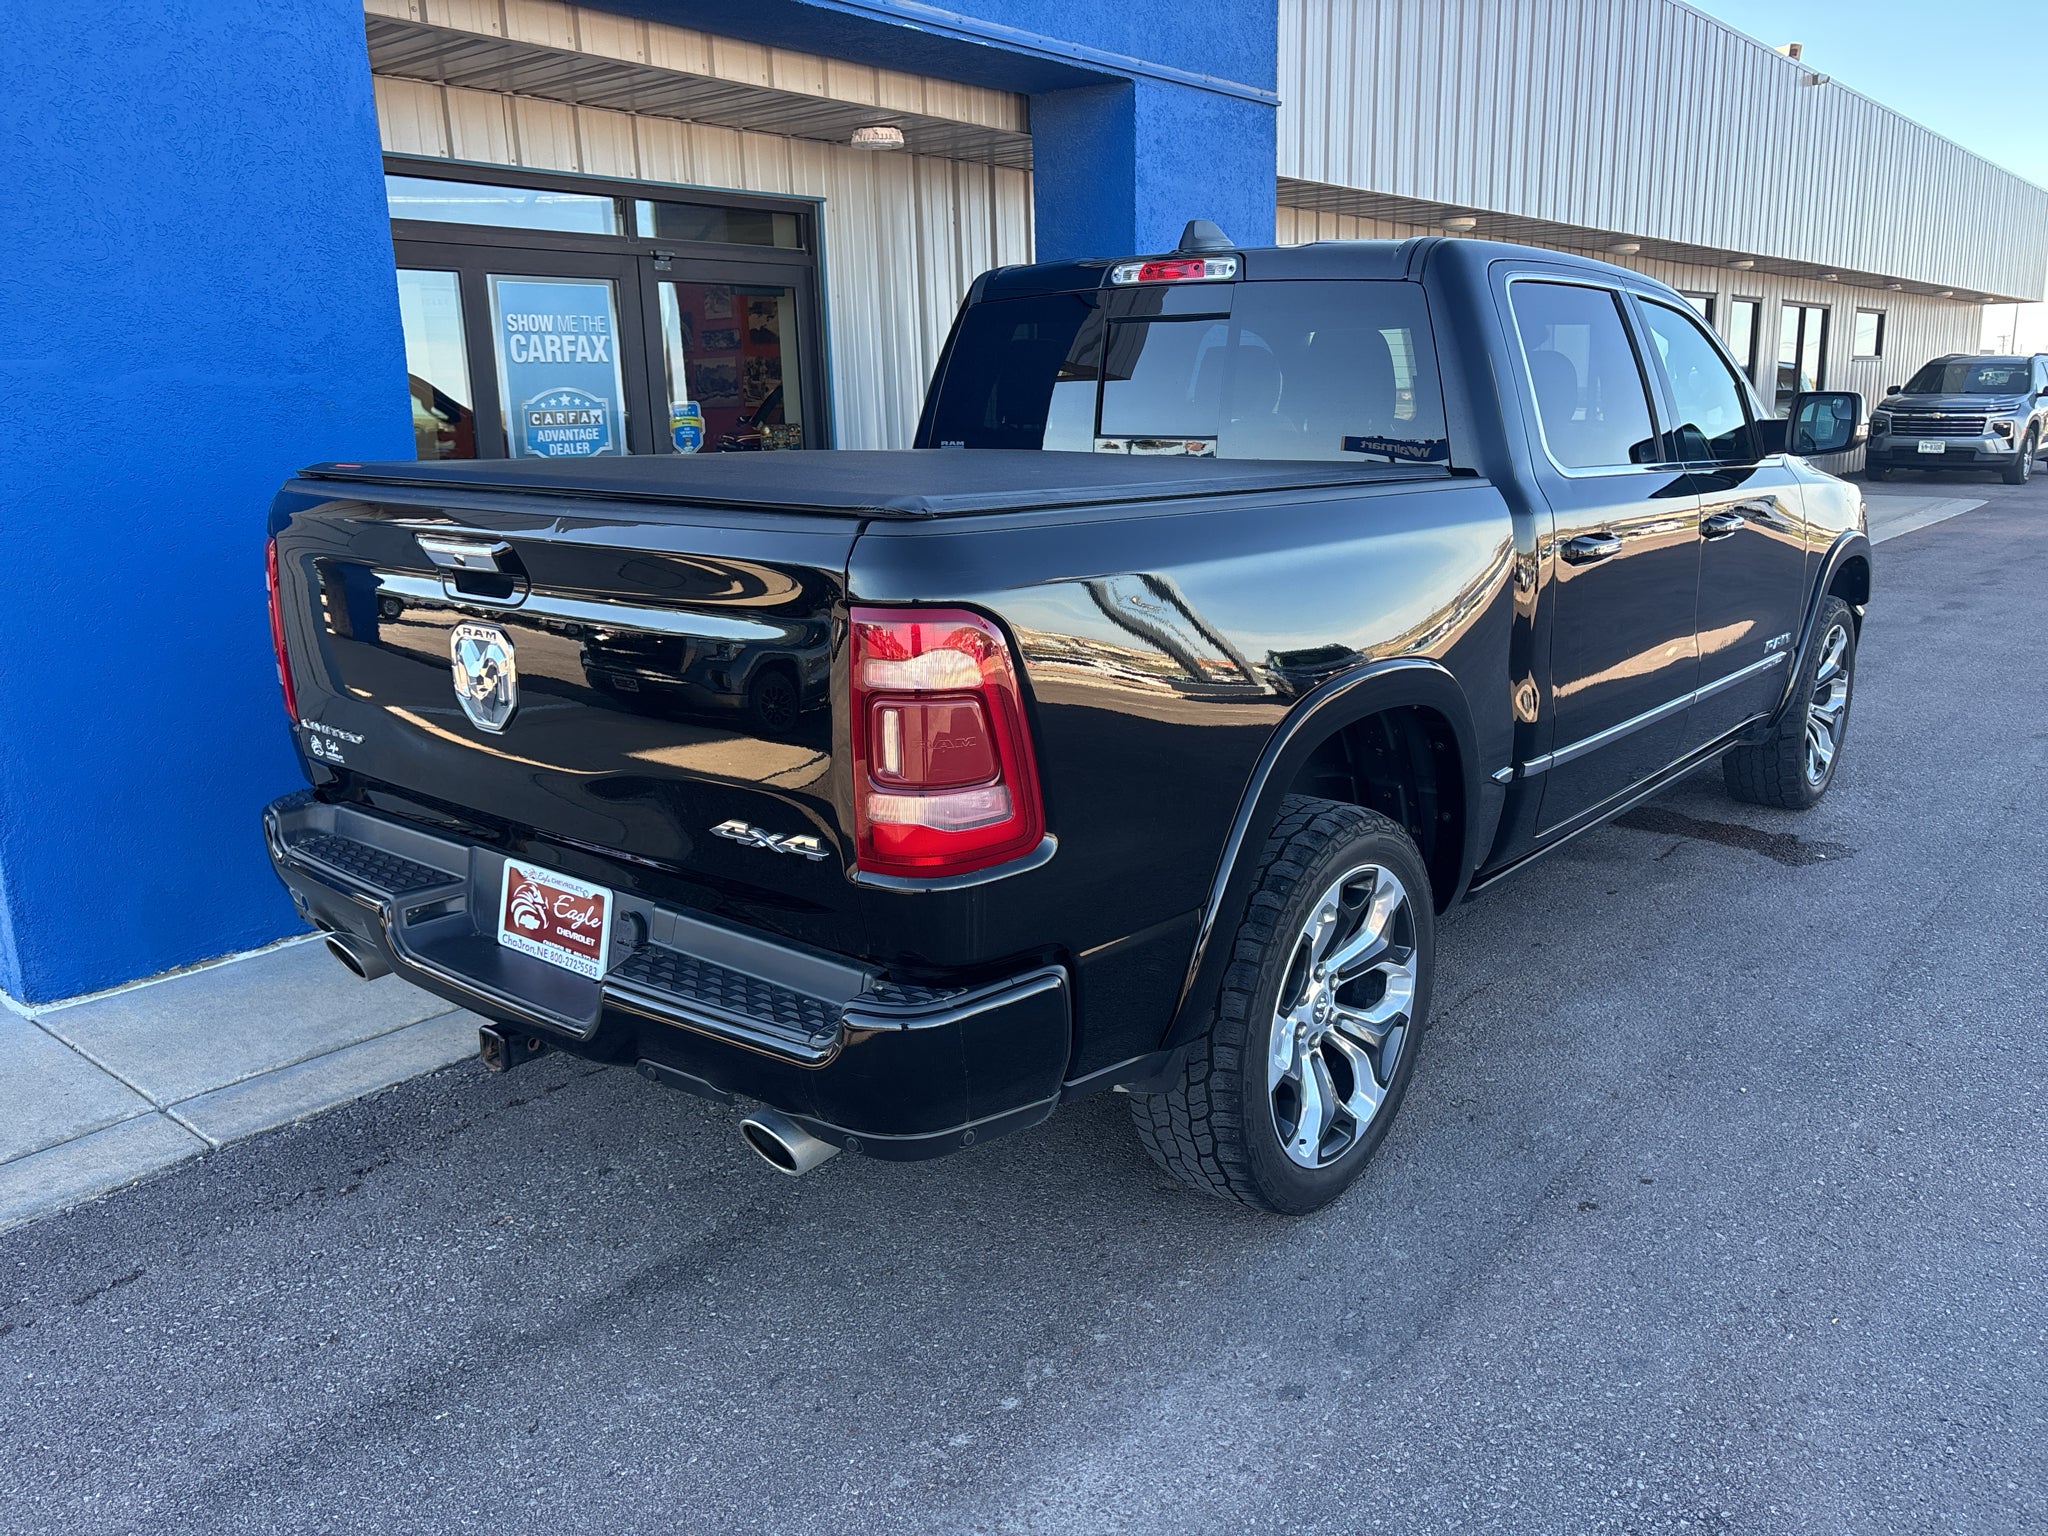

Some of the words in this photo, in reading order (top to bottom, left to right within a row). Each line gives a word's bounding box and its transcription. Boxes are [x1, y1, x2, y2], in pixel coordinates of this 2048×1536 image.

[506, 314, 553, 332] SHOW
[557, 315, 578, 332] ME
[580, 315, 607, 333] THE
[510, 334, 609, 364] CARFAX
[531, 411, 603, 425] CARFAX
[537, 428, 599, 442] ADVANTAGE
[549, 442, 590, 456] DEALER
[463, 627, 497, 640] RAM
[553, 895, 601, 929] Eagle
[556, 926, 596, 947] CHEVROLET
